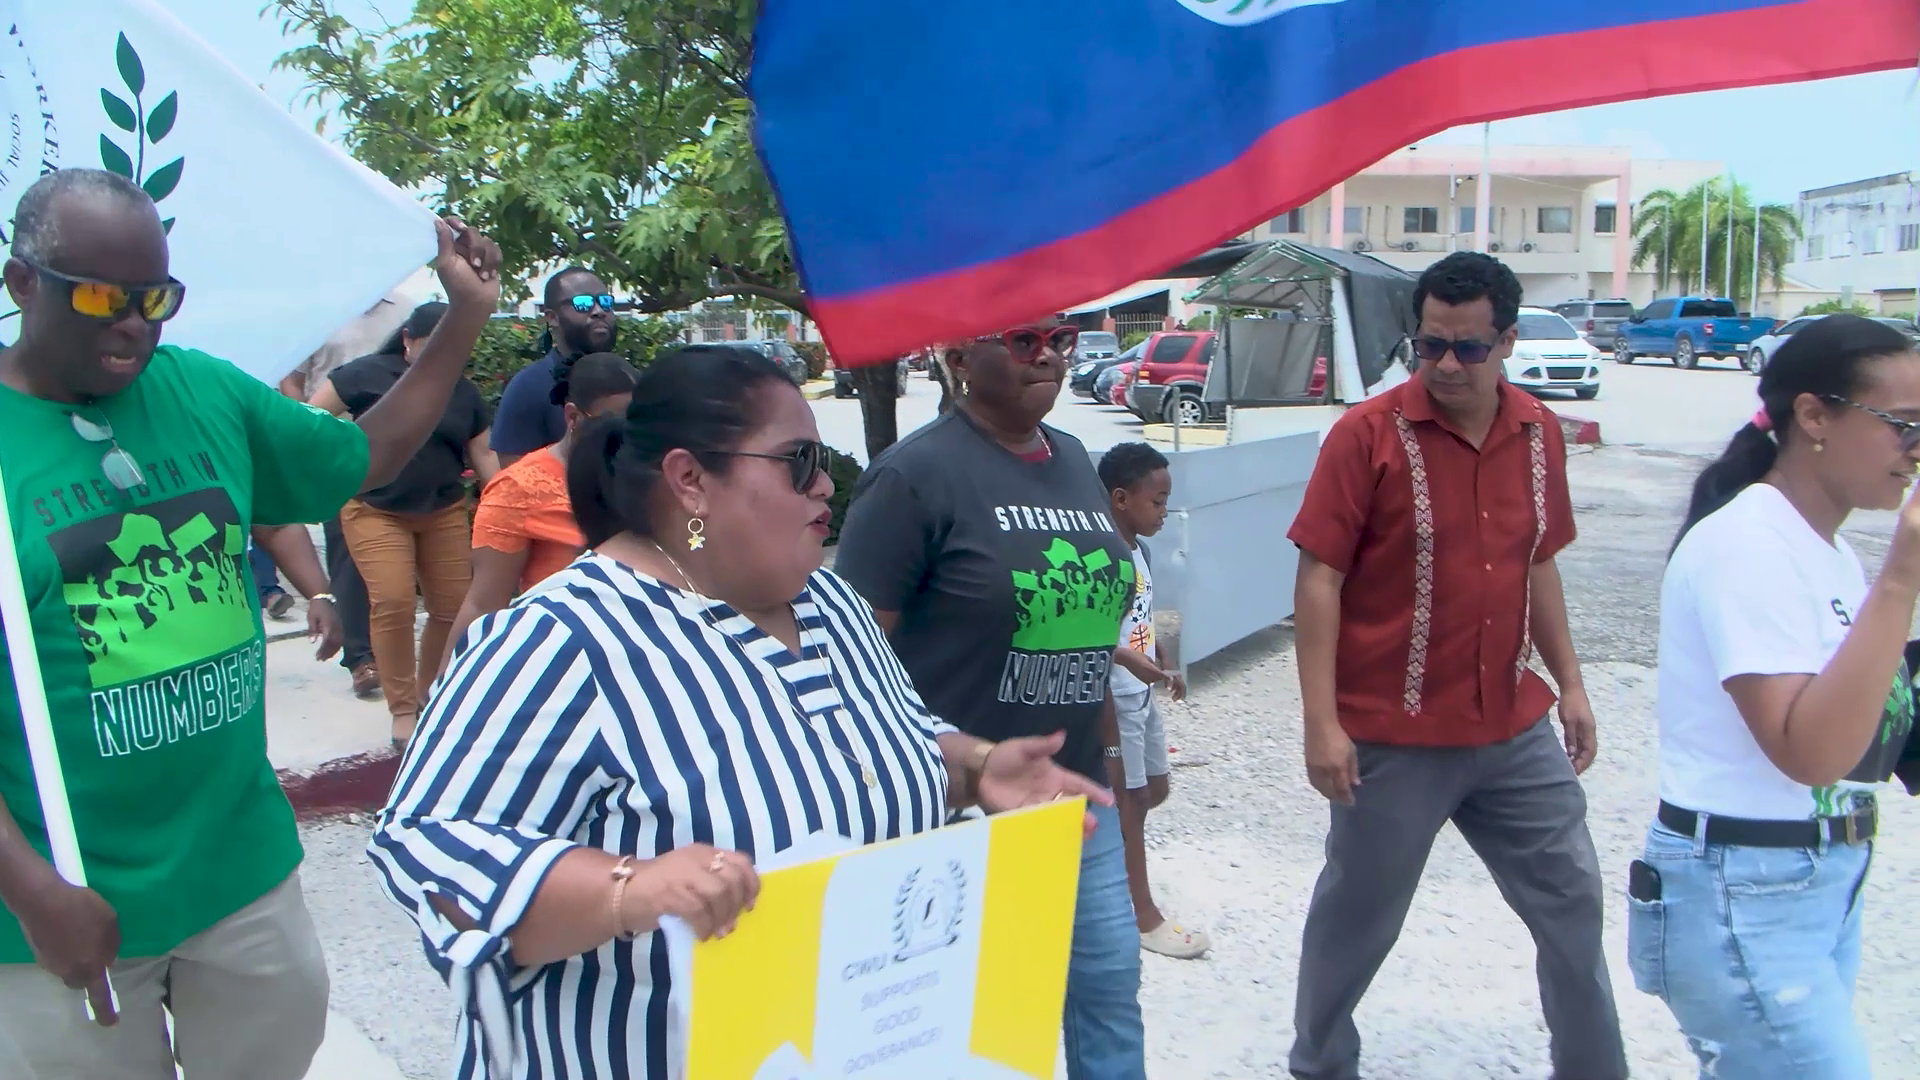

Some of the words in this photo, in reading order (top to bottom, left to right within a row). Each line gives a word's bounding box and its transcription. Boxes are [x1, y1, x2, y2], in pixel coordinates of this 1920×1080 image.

[7, 112, 20, 169] SOCIAL
[188, 451, 219, 482] IN
[994, 505, 1093, 532] STRENGTH
[1092, 511, 1114, 533] IN
[91, 639, 262, 757] NUMBERS
[997, 650, 1113, 706] NUMBER
